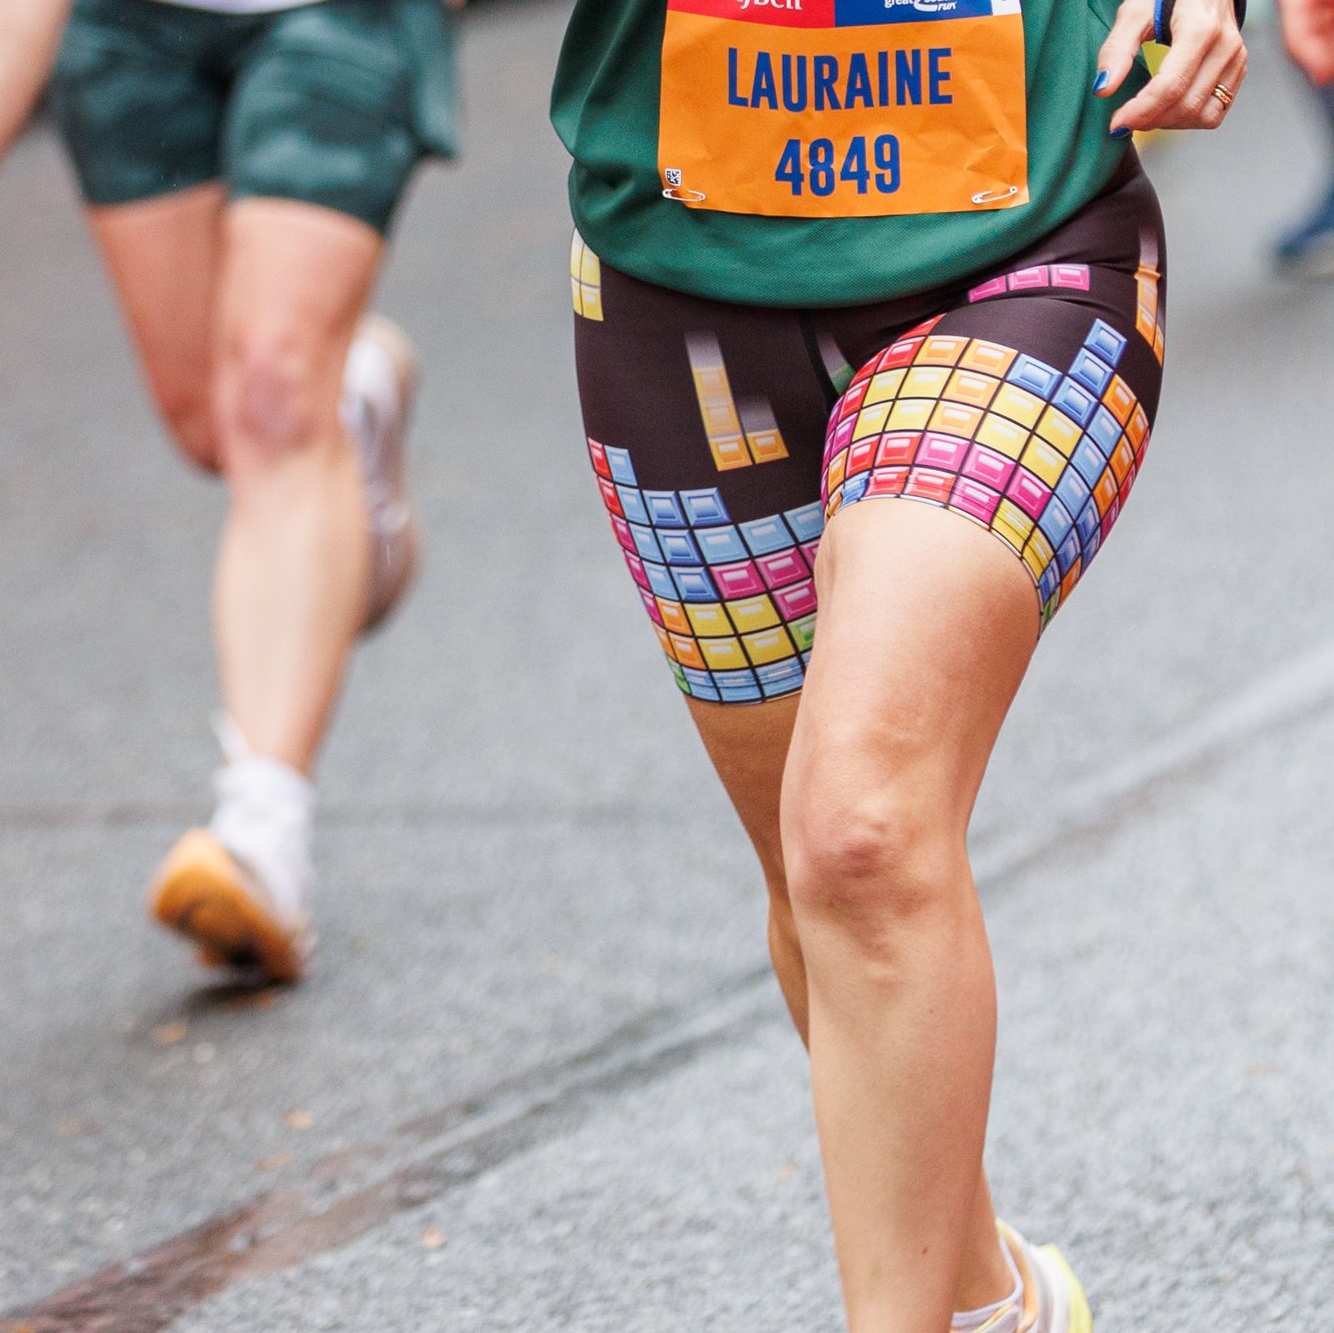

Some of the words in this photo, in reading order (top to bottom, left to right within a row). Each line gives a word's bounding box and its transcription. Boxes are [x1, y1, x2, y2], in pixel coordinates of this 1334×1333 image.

[937, 1, 957, 11] run
[726, 45, 954, 112] LAURAINE
[774, 133, 901, 197] 4849
